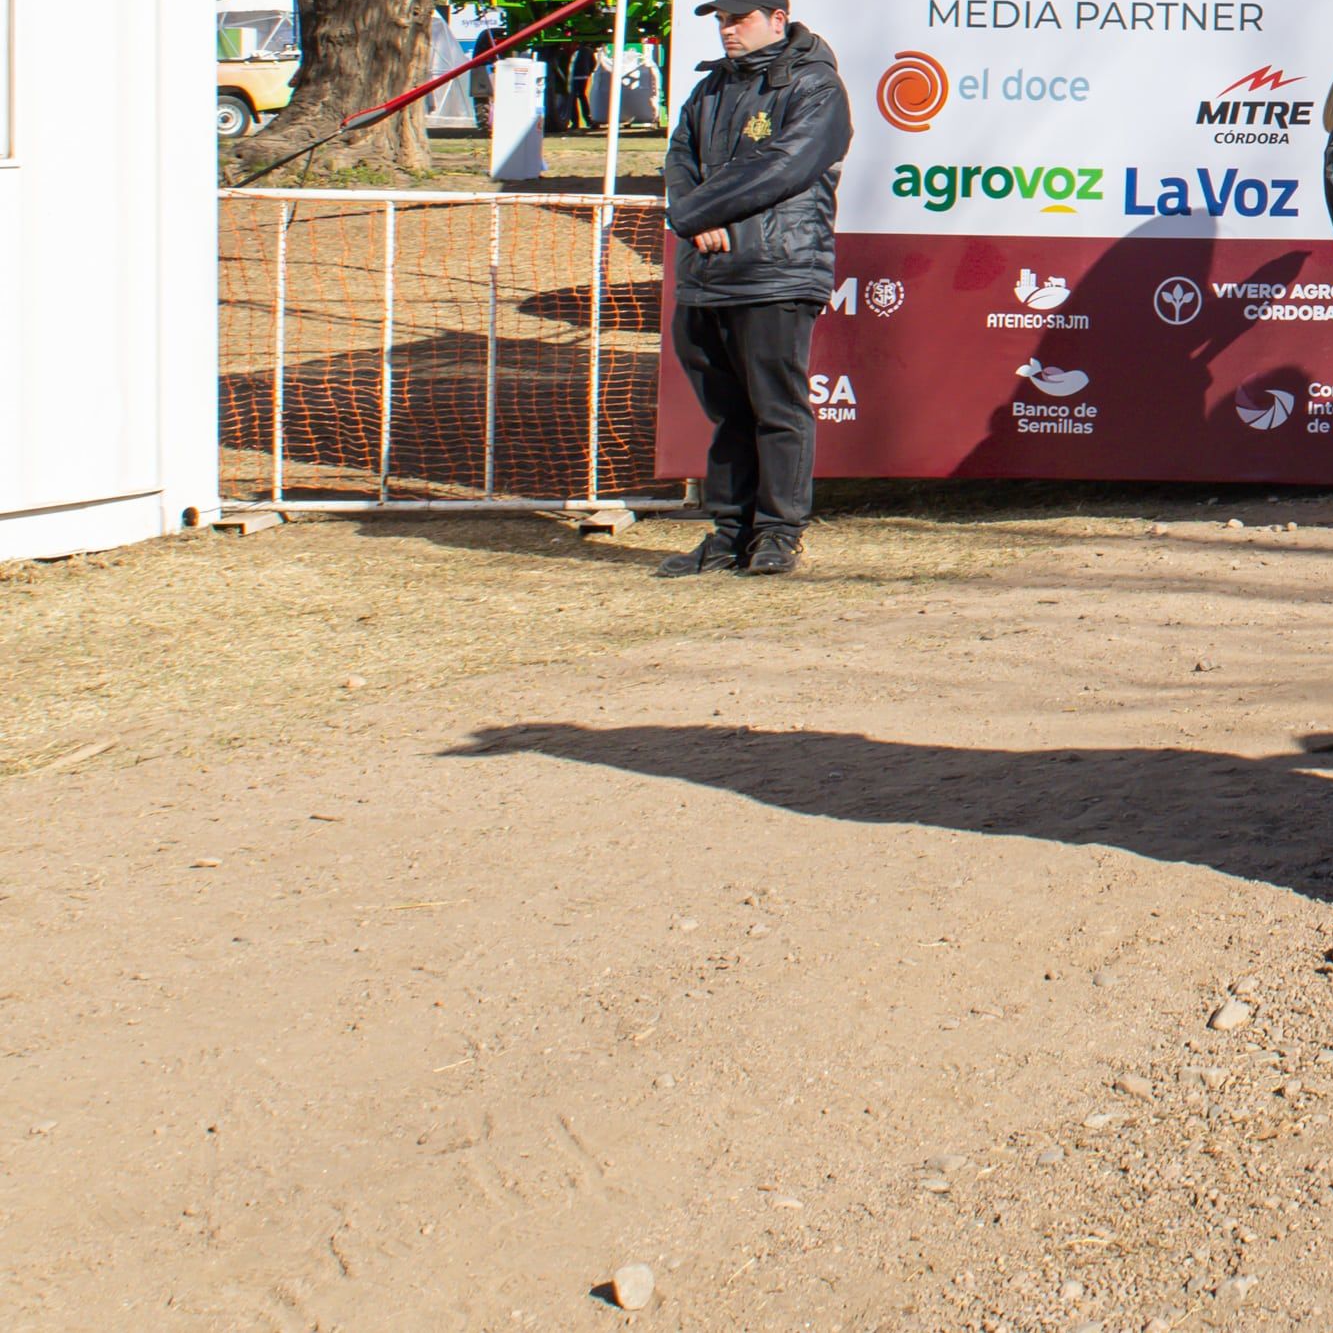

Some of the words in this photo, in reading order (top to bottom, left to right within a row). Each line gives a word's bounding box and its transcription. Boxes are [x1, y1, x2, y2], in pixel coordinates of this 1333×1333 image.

[928, 0, 1061, 29] MEDIA
[1075, 2, 1264, 32] PARTNER
[958, 68, 989, 100] el
[1002, 69, 1090, 102] doce
[1196, 100, 1315, 129] MITRE
[1214, 131, 1290, 145] CÓRDOBA
[891, 163, 1104, 213] agrovoz
[1212, 283, 1286, 298] VIVERO
[1012, 402, 1069, 417] Banco
[1074, 403, 1097, 417] de
[1017, 418, 1093, 434] Semillas
[1307, 419, 1330, 433] de
